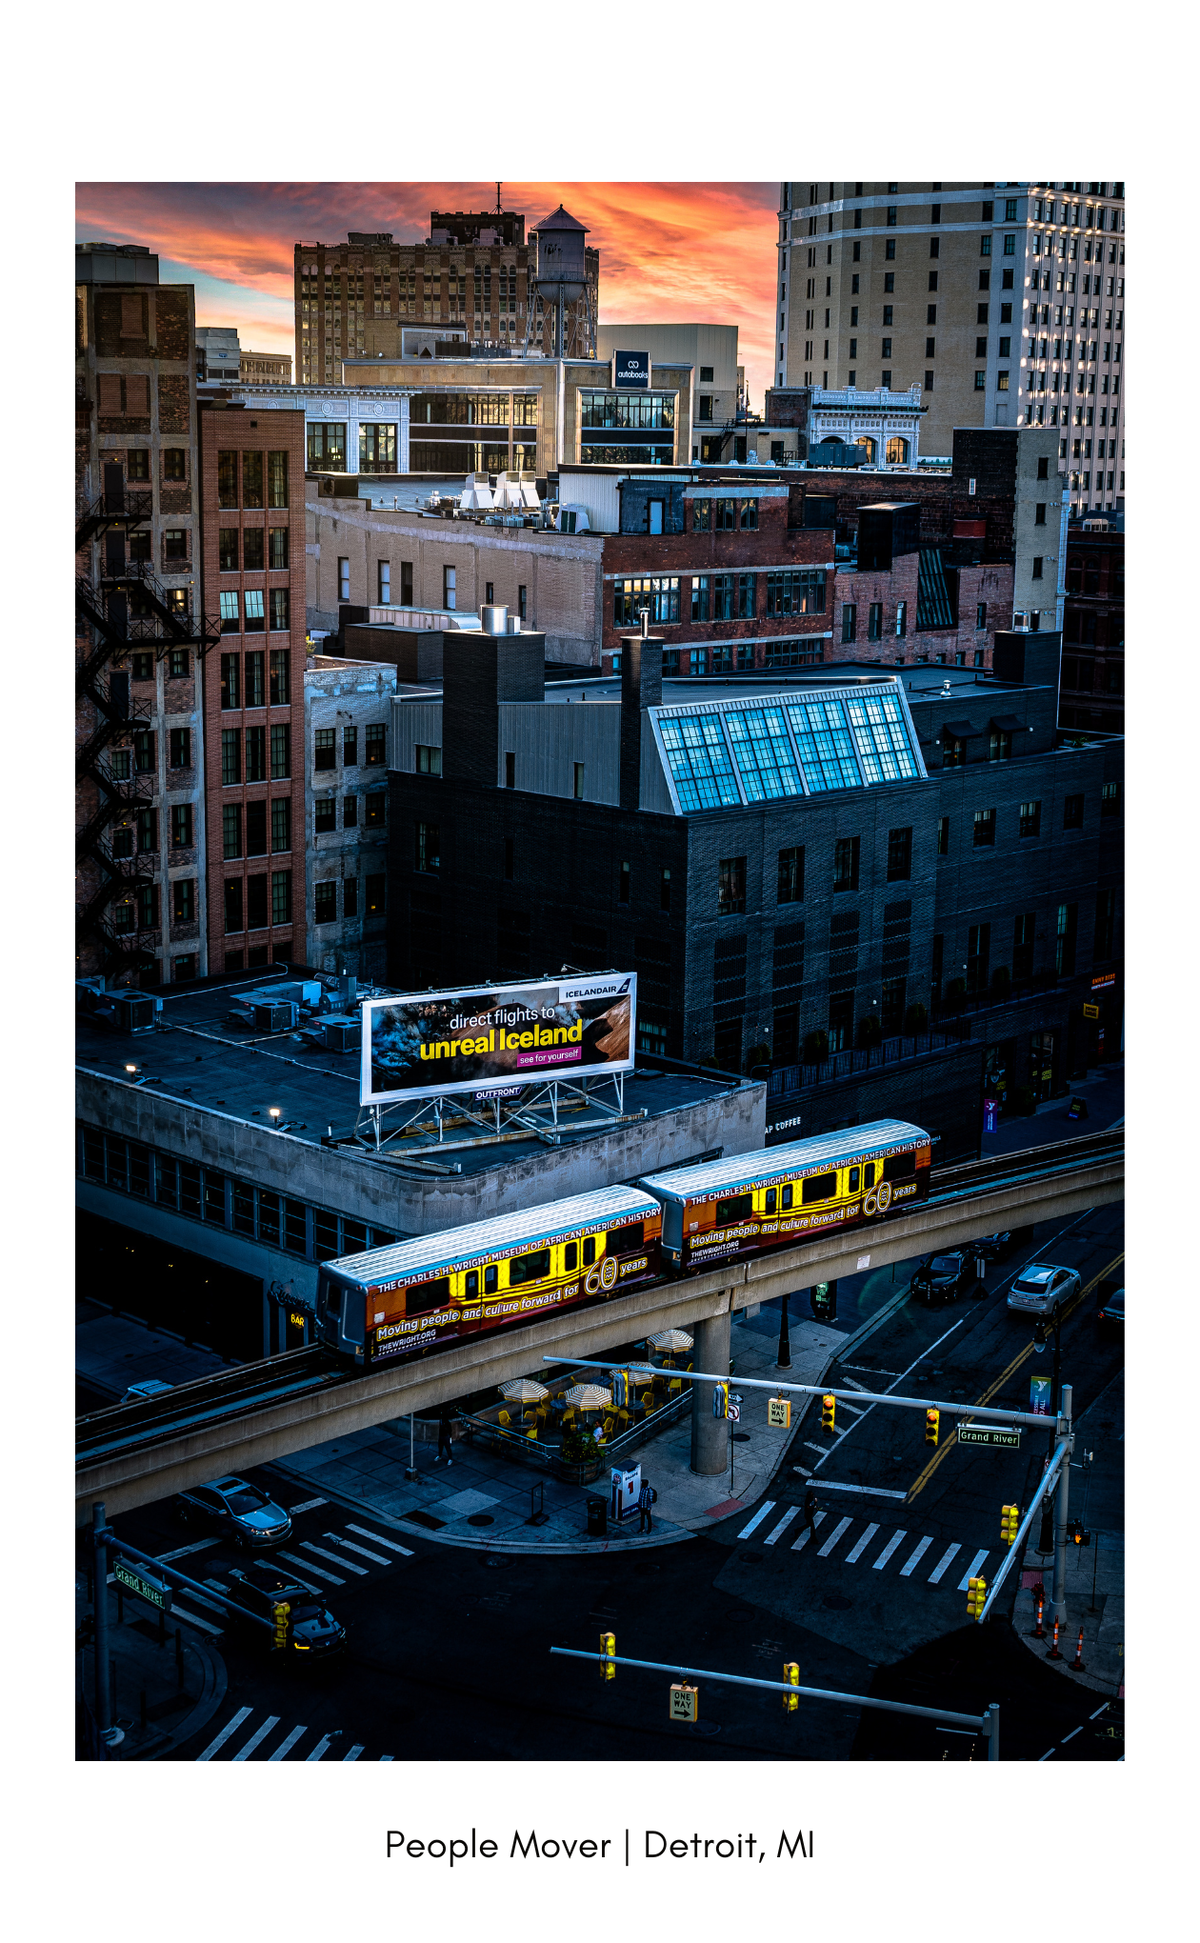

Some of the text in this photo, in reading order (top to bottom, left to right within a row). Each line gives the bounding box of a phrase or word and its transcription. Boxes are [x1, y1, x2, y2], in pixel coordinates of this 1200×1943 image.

[618, 370, 649, 379] autobooks
[565, 985, 617, 998] ICELANDAIR
[450, 1006, 555, 1030] direct flights to
[420, 1019, 583, 1060] unreal Iceland
[520, 1049, 579, 1064] see for yourself
[476, 1087, 520, 1099] OUTFRONT
[775, 1116, 802, 1131] COFFEE
[691, 1139, 931, 1205] THE CHARLES H. WRIGHT MUSEUM OF AFRICAN AMERICAN HISTORY
[691, 1231, 725, 1247] Moving
[727, 1224, 758, 1239] people
[762, 1222, 779, 1233] and
[810, 1209, 844, 1225] forward
[847, 1205, 859, 1216] for
[864, 1181, 892, 1215] 60
[893, 1184, 916, 1199] years
[377, 1207, 662, 1293] THE CHARLES H. WRIGHT MUSEUM OF AFRICAN AMERICAN HISTORY
[691, 1240, 740, 1258] THEWRIGHT.ORG
[377, 1320, 418, 1340] Moving
[421, 1310, 459, 1328] people
[463, 1306, 483, 1319] and
[521, 1289, 561, 1308] forward
[564, 1284, 579, 1297] for
[585, 1256, 618, 1293] 60
[620, 1259, 647, 1275] years
[291, 1313, 304, 1327] BAR
[378, 1329, 437, 1352] THEWRIGHT.ORG
[771, 1403, 785, 1411] ONE
[771, 1410, 785, 1418] WAY
[960, 1431, 1018, 1444] Grand River
[115, 1565, 163, 1605] Grand River
[674, 1692, 691, 1701] ONE
[674, 1700, 691, 1709] WAY
